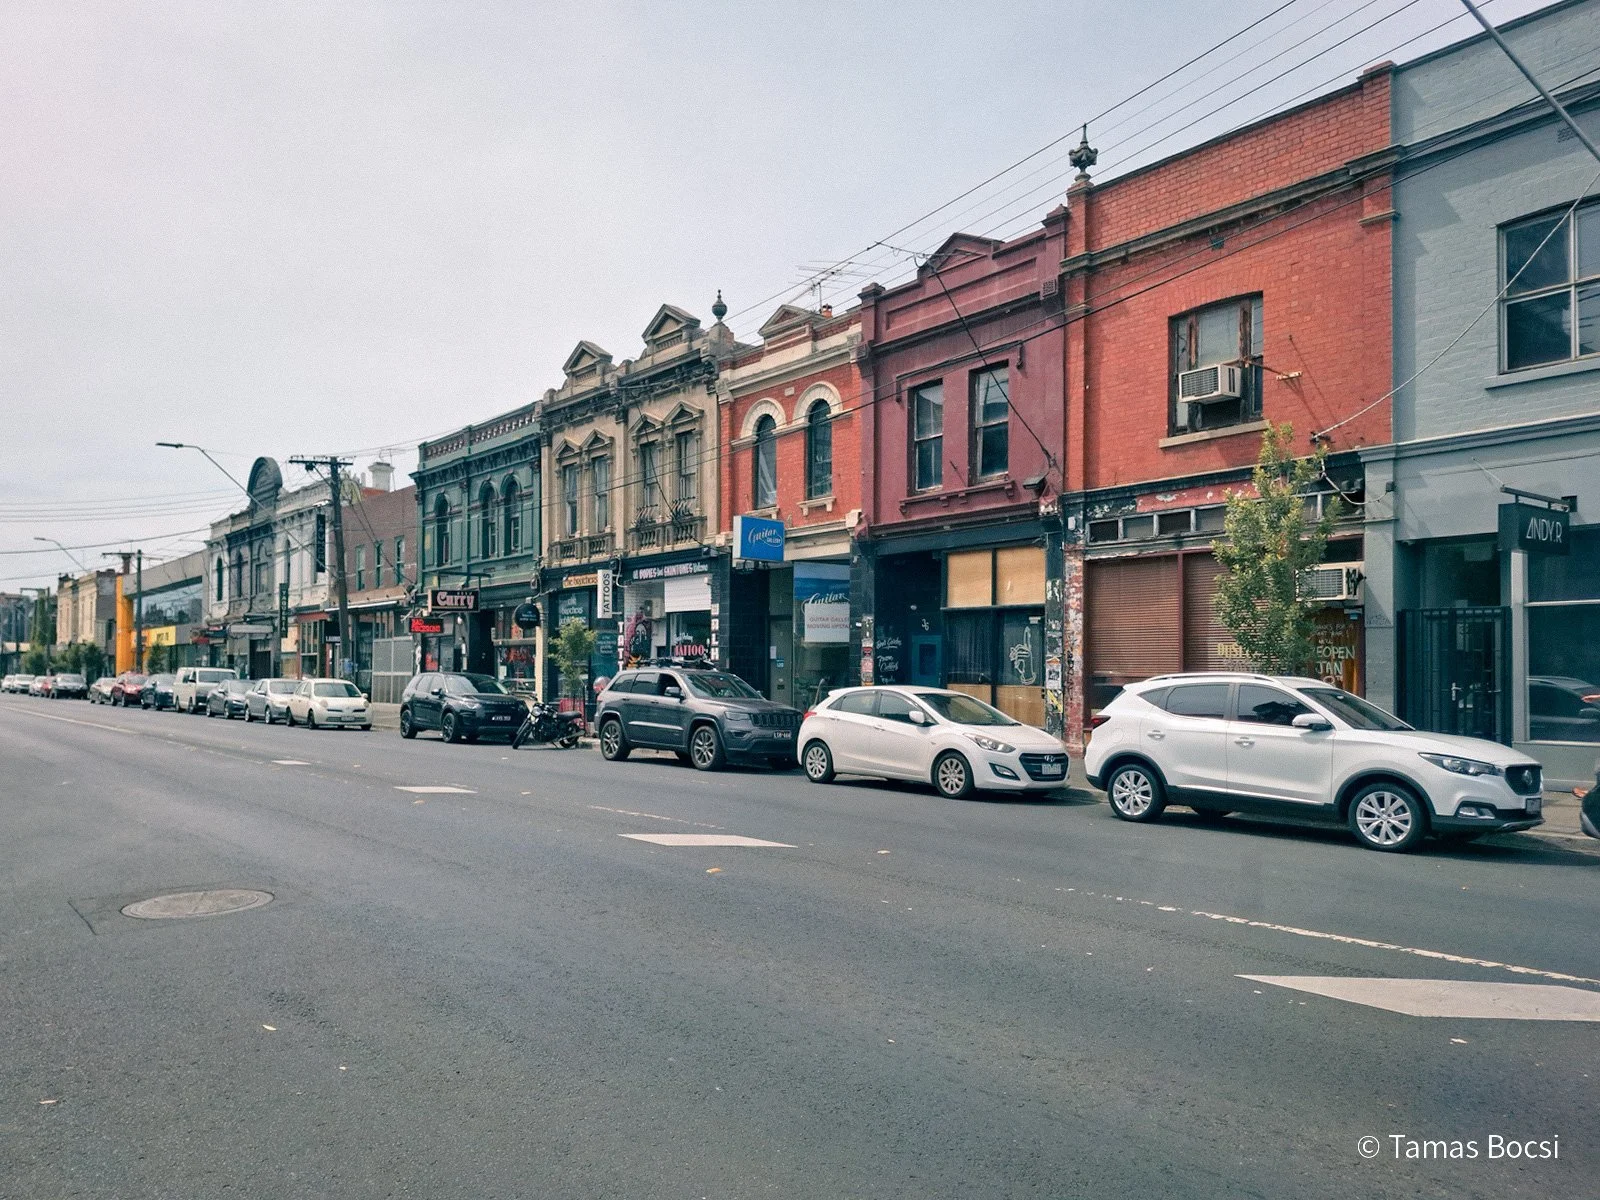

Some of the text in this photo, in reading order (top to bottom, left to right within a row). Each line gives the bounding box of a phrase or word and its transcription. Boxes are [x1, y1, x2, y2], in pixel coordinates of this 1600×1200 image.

[748, 527, 778, 545] Guitar
[436, 591, 475, 610] Curry
[603, 573, 611, 614] TATTOOS
[675, 644, 705, 657] TATTOO
[1316, 661, 1343, 676] JAN
